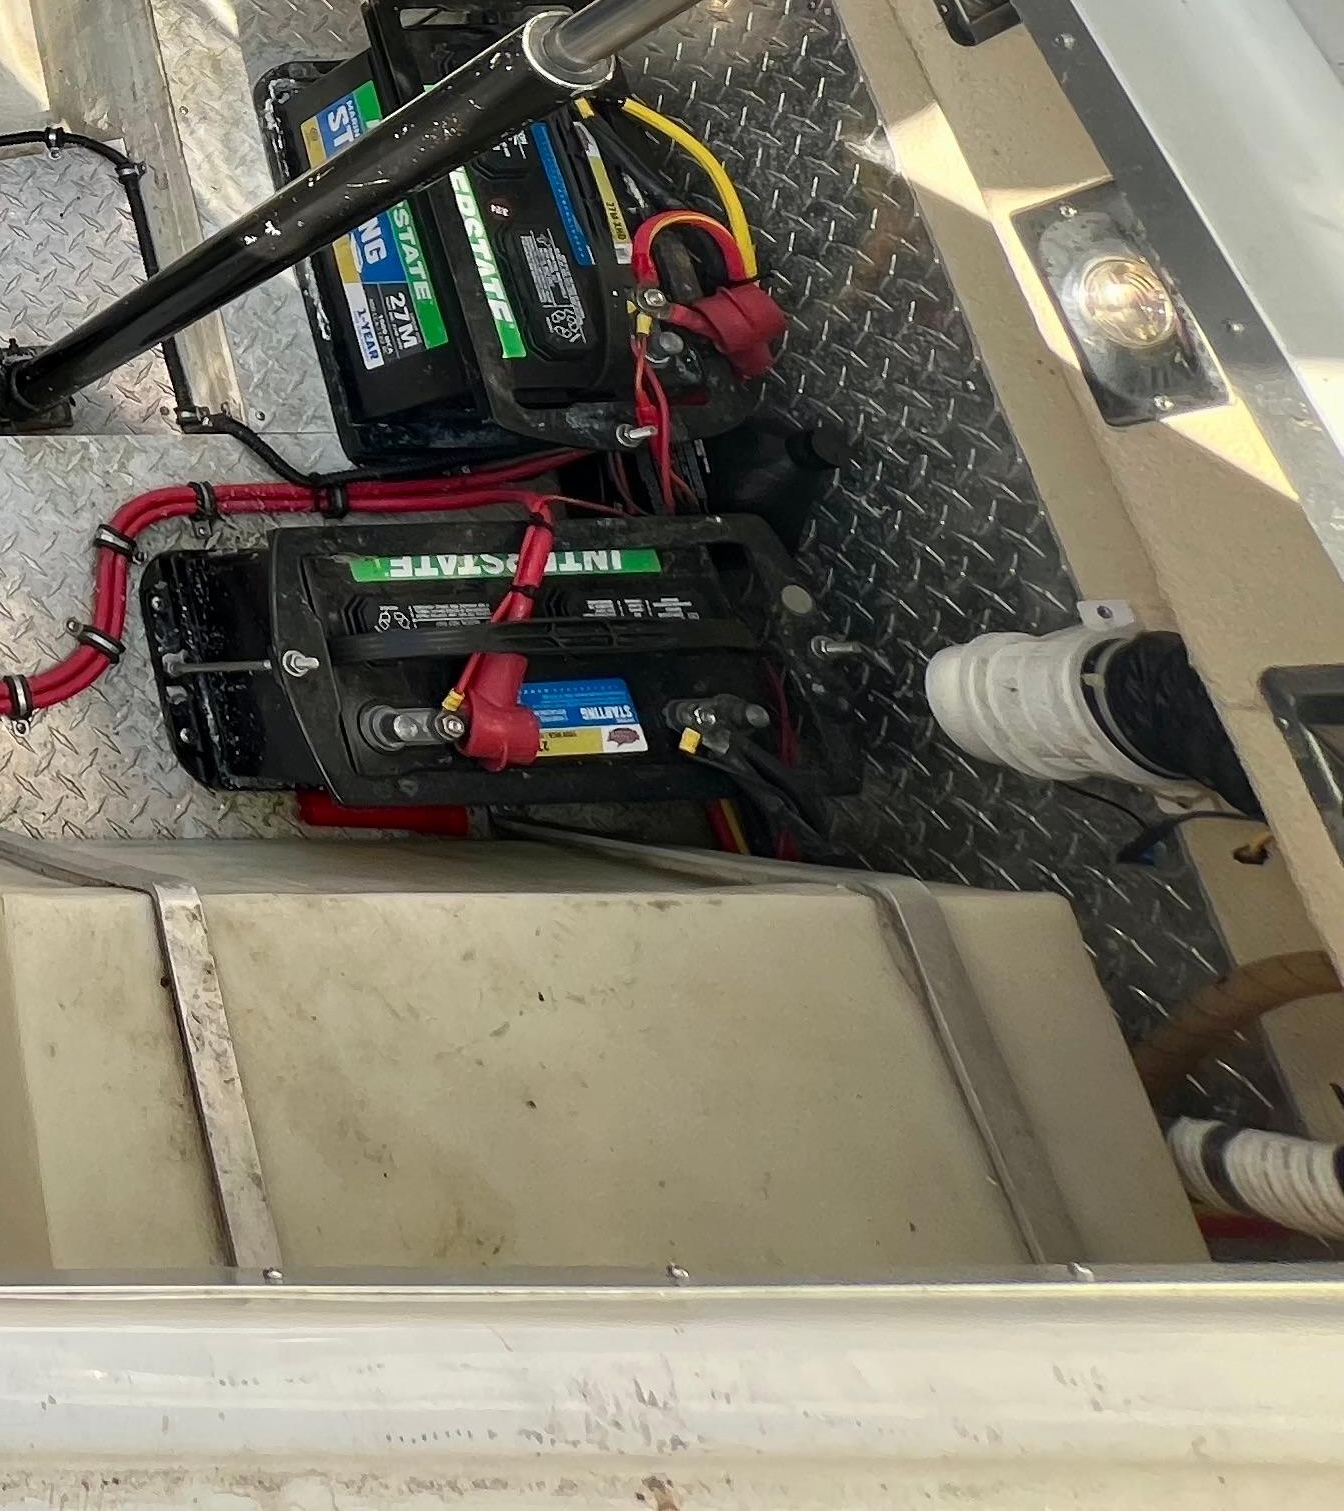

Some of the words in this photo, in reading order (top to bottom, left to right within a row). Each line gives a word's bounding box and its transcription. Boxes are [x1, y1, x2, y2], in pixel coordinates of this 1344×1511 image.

[356, 309, 380, 360] 1-YEAR
[385, 291, 418, 349] 27M
[580, 704, 634, 720] STARTING
